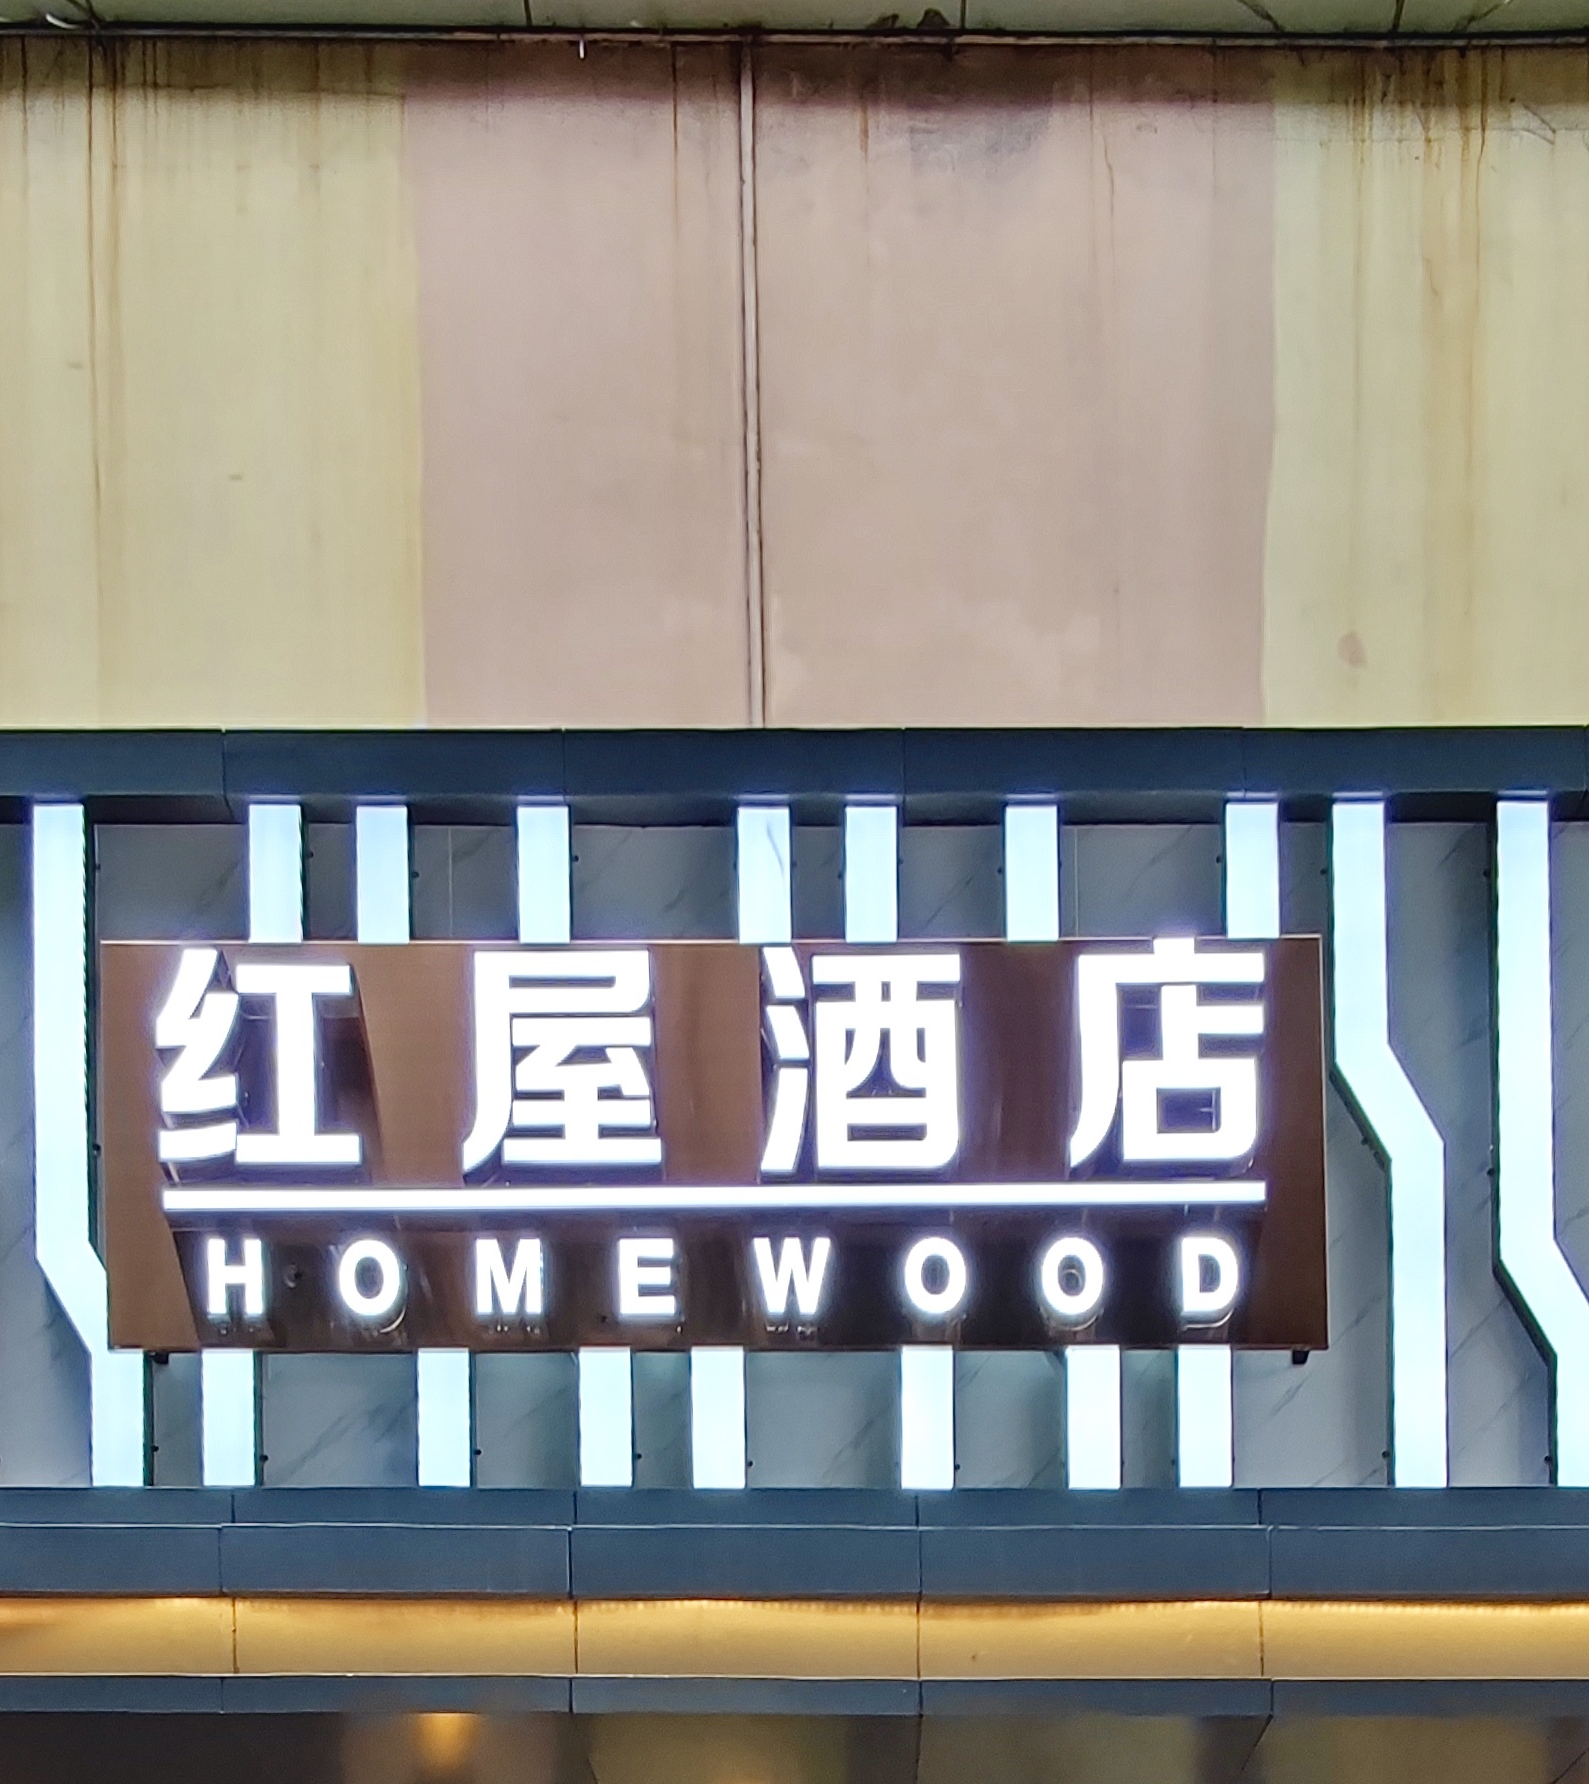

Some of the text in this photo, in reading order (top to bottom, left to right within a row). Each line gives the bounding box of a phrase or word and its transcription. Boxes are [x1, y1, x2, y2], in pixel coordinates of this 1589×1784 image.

[155, 941, 1267, 1174] 红屋酒店
[206, 1237, 1240, 1318] HOMEWOOD
